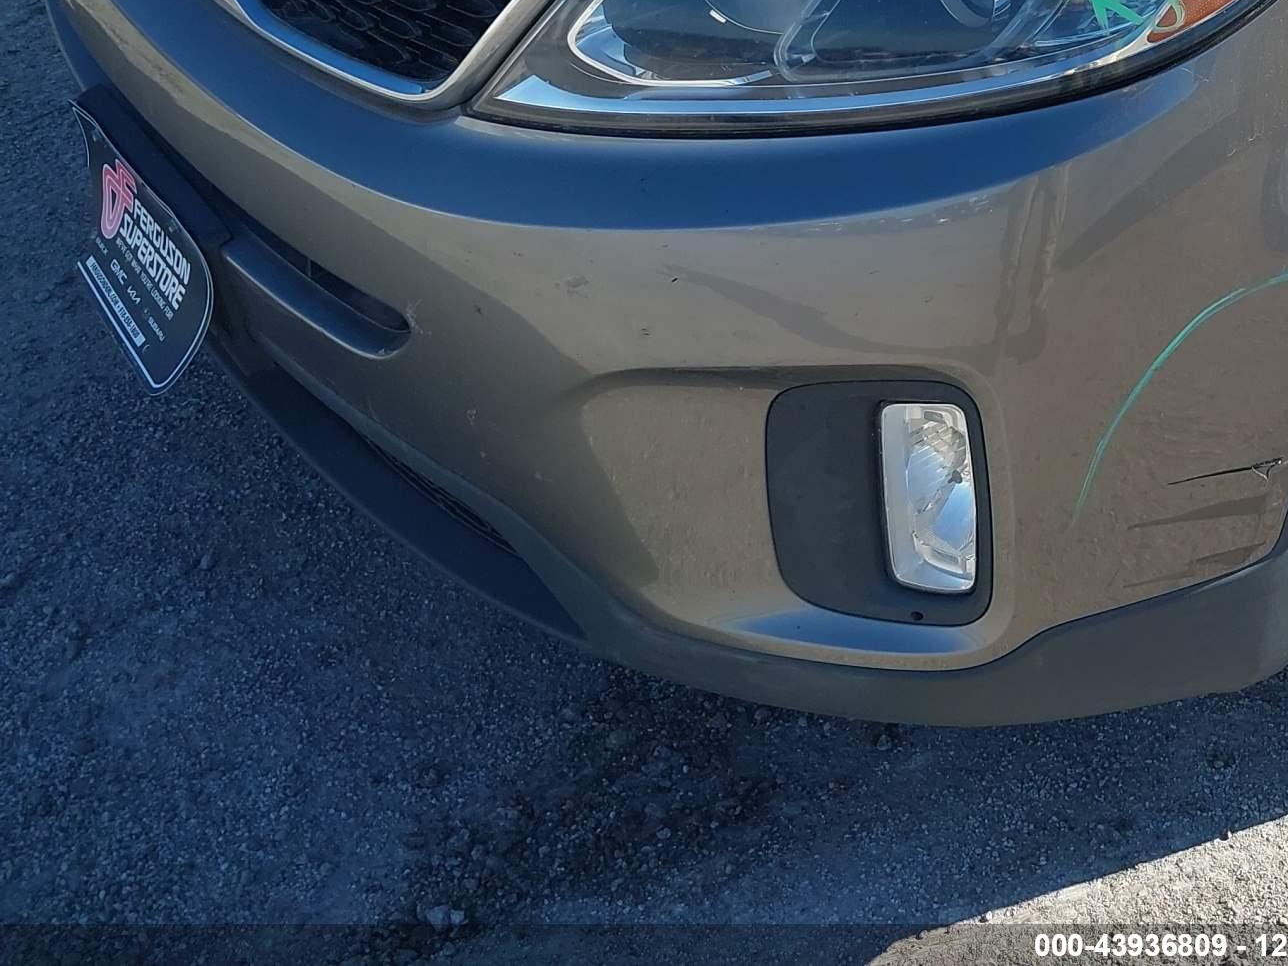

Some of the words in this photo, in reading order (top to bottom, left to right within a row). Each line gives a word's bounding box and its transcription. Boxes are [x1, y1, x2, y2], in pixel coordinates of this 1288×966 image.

[110, 258, 128, 286] GMC
[119, 212, 187, 311] SUPERSTORE
[133, 197, 191, 285] FERGUSON
